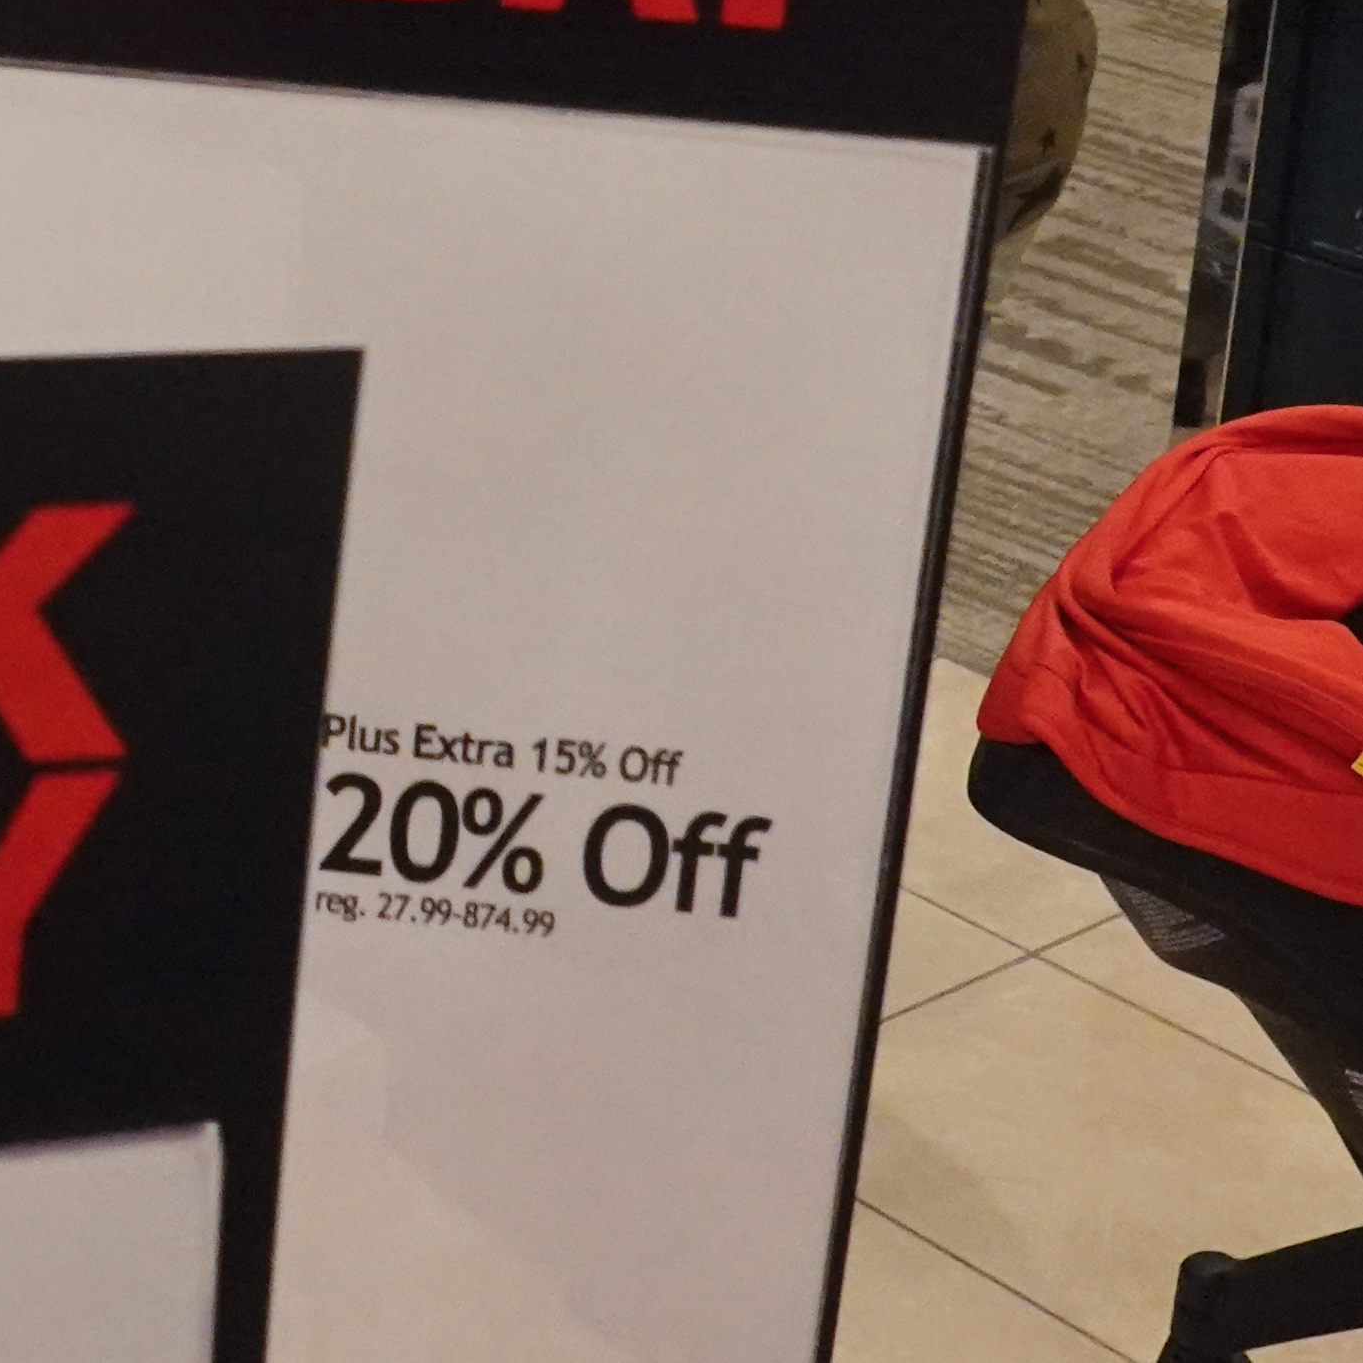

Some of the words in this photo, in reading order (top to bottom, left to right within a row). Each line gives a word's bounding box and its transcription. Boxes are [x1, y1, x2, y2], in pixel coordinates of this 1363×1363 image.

[320, 712, 400, 757] Plus
[413, 723, 515, 769] Extra
[532, 737, 607, 779] 15%
[619, 745, 683, 787] Off
[319, 772, 545, 895] 20%
[582, 802, 773, 918] Off
[314, 889, 365, 923] reg.
[377, 892, 555, 936] 27.99-874.99
